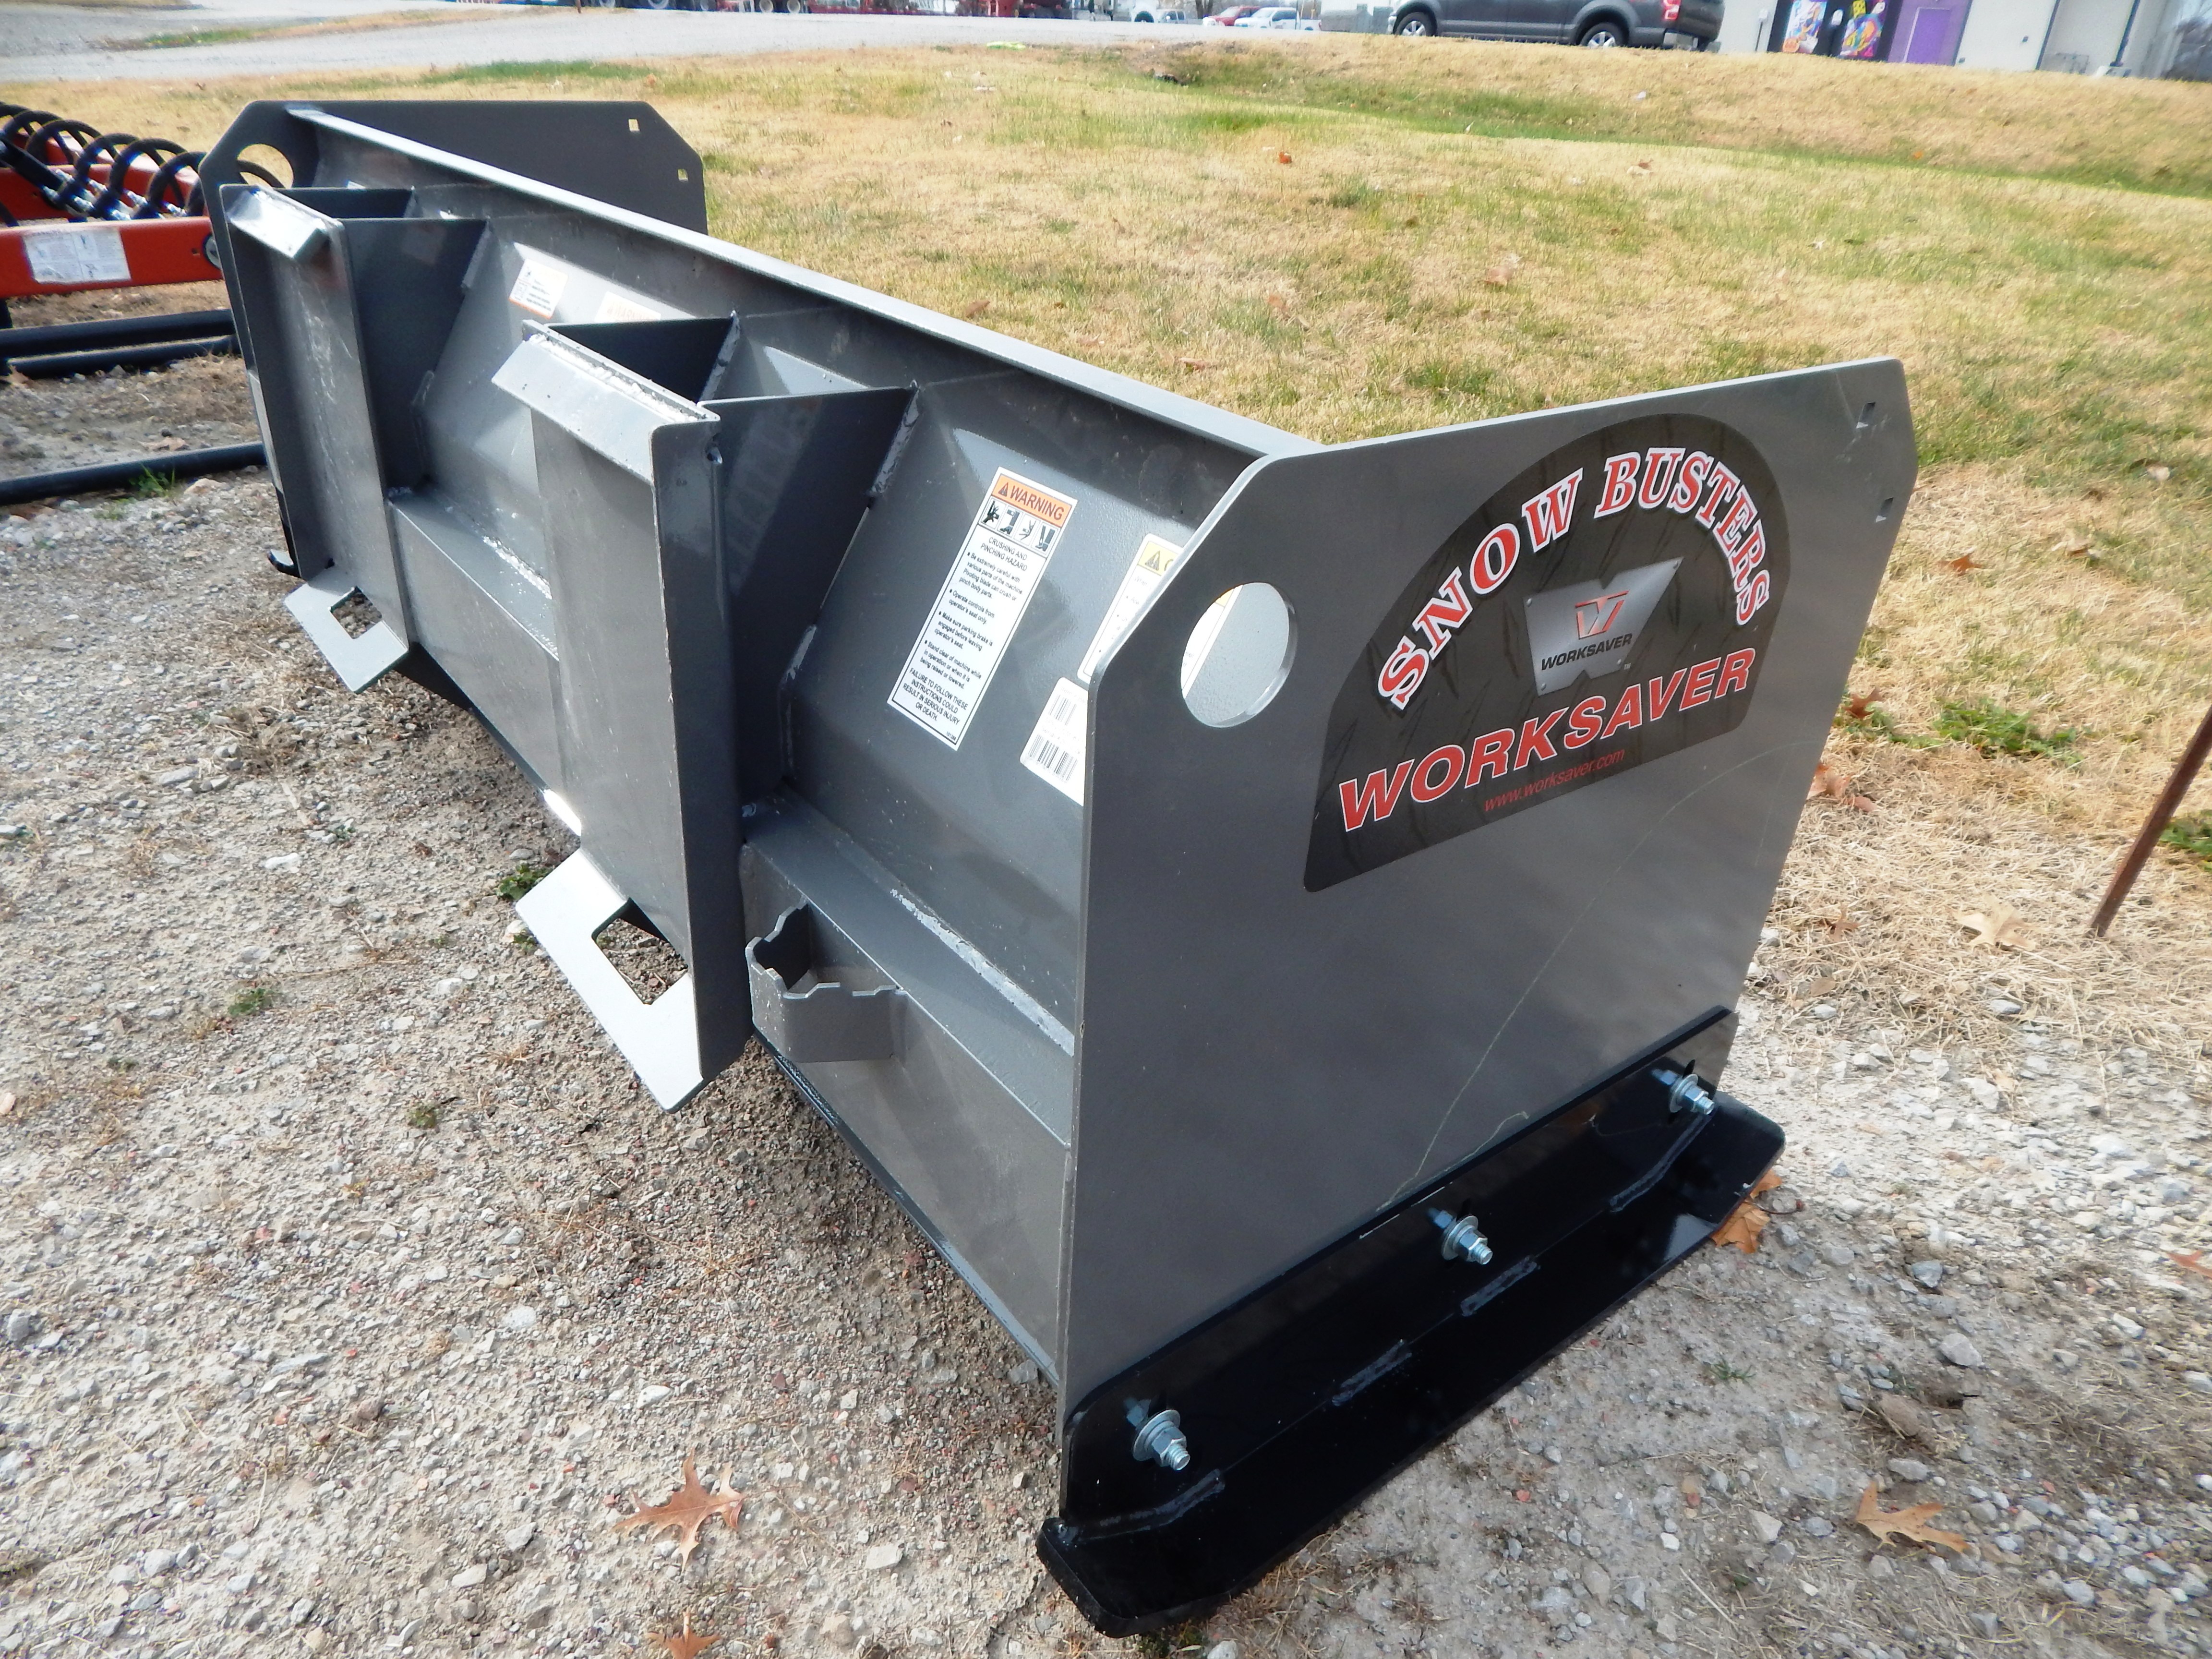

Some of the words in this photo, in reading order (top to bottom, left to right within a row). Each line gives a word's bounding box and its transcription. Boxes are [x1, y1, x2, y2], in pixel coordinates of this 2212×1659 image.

[1010, 485, 1064, 520] WARNING
[980, 543, 1006, 560] PINCHING
[1005, 556, 1028, 571] HAZARD
[989, 537, 1015, 555] CRUSHING
[1015, 551, 1027, 561] AND
[967, 562, 982, 573] various
[981, 570, 992, 578] parts
[977, 557, 996, 571] extremely
[997, 568, 1011, 578] careful
[1378, 468, 1583, 710] SNOW
[1594, 447, 1770, 625] BUSTERS
[959, 577, 971, 586] pinch
[971, 582, 981, 593] body
[963, 568, 980, 583] Pivoting
[979, 577, 991, 588] blade
[999, 589, 1011, 598] crush
[949, 599, 969, 613] operator's
[969, 610, 978, 619] seat
[953, 590, 968, 603] Operate
[968, 600, 985, 613] controls
[985, 608, 995, 618] from
[934, 628, 954, 643] operator's
[938, 621, 956, 634] engaged
[955, 630, 968, 641] before
[968, 637, 983, 652] leaving
[942, 612, 952, 622] Make
[952, 620, 962, 628] sure
[961, 625, 977, 638] parking
[977, 633, 988, 644] brake
[920, 657, 931, 669] being
[931, 664, 944, 675] raised
[927, 641, 940, 653] Stand
[939, 650, 950, 659] clear
[953, 659, 971, 673] machine
[971, 670, 982, 679] while
[928, 653, 947, 667] operation
[951, 668, 962, 677] when
[1541, 633, 1633, 671] WORKSAVER
[902, 683, 920, 698] RESULT
[924, 697, 944, 715] SERIOUS
[943, 710, 960, 725] INJURY
[909, 668, 928, 684] FAILURE
[927, 679, 935, 688] TO
[933, 684, 953, 700] FOLLOW
[953, 696, 968, 710] THESE
[911, 679, 943, 703] INSTRUCTIONS
[942, 699, 958, 714] COULD
[915, 702, 923, 710] OR
[922, 706, 938, 721] DEATH.
[1339, 648, 1755, 832] WORKSAVER
[1484, 749, 1625, 811] www.worksaver.com
